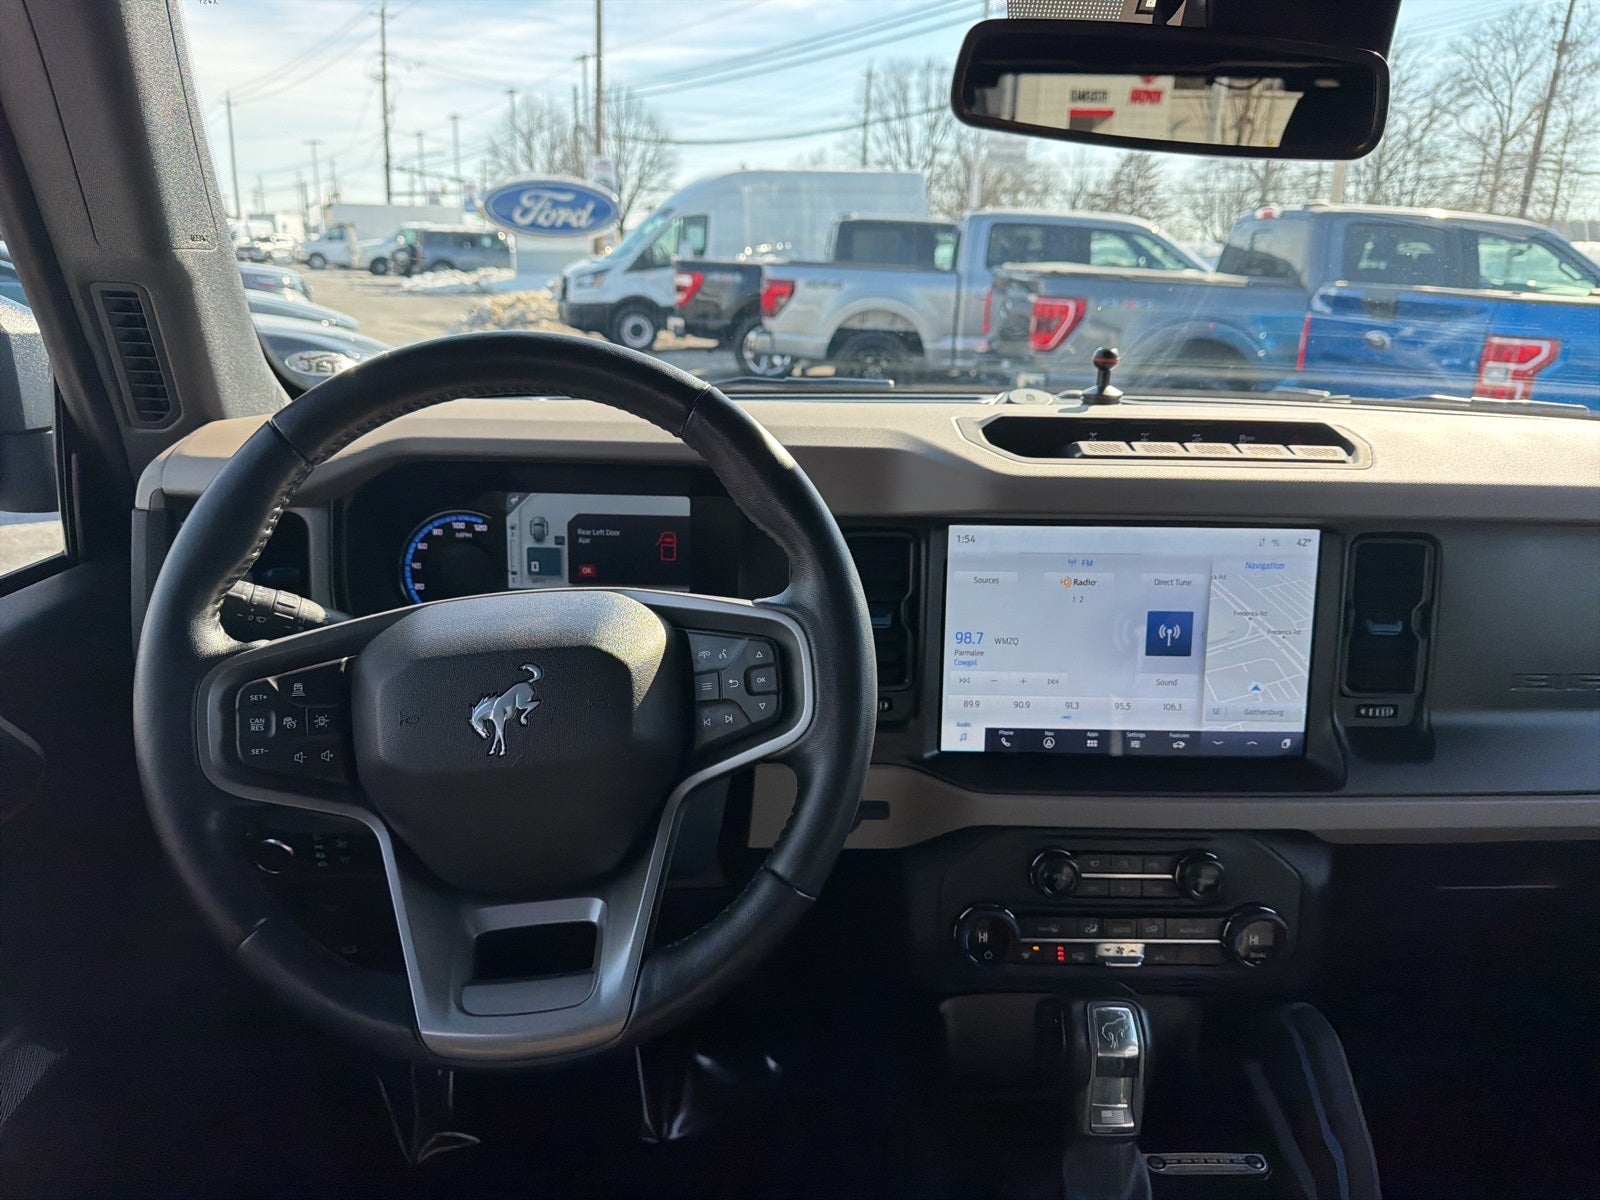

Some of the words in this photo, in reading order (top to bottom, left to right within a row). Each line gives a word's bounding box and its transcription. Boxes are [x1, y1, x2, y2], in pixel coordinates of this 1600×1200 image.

[512, 188, 595, 228] Ford
[578, 528, 591, 536] Rear
[956, 534, 976, 544] 1:54
[1245, 561, 1285, 570] Navigation
[974, 576, 999, 584] Sources
[1073, 578, 1096, 586] Radio
[1154, 578, 1172, 586] Direct
[1174, 578, 1192, 586] Tune
[955, 632, 984, 644] 98.7
[995, 637, 1019, 646] WMZQ
[954, 658, 977, 667] Cowgirl
[1156, 678, 1177, 686] Sound
[963, 700, 980, 708] 89.9
[1013, 701, 1030, 709] 90.9
[1065, 702, 1079, 710] 91.3
[1114, 702, 1131, 710] 95.5
[1163, 703, 1182, 711] 106.3
